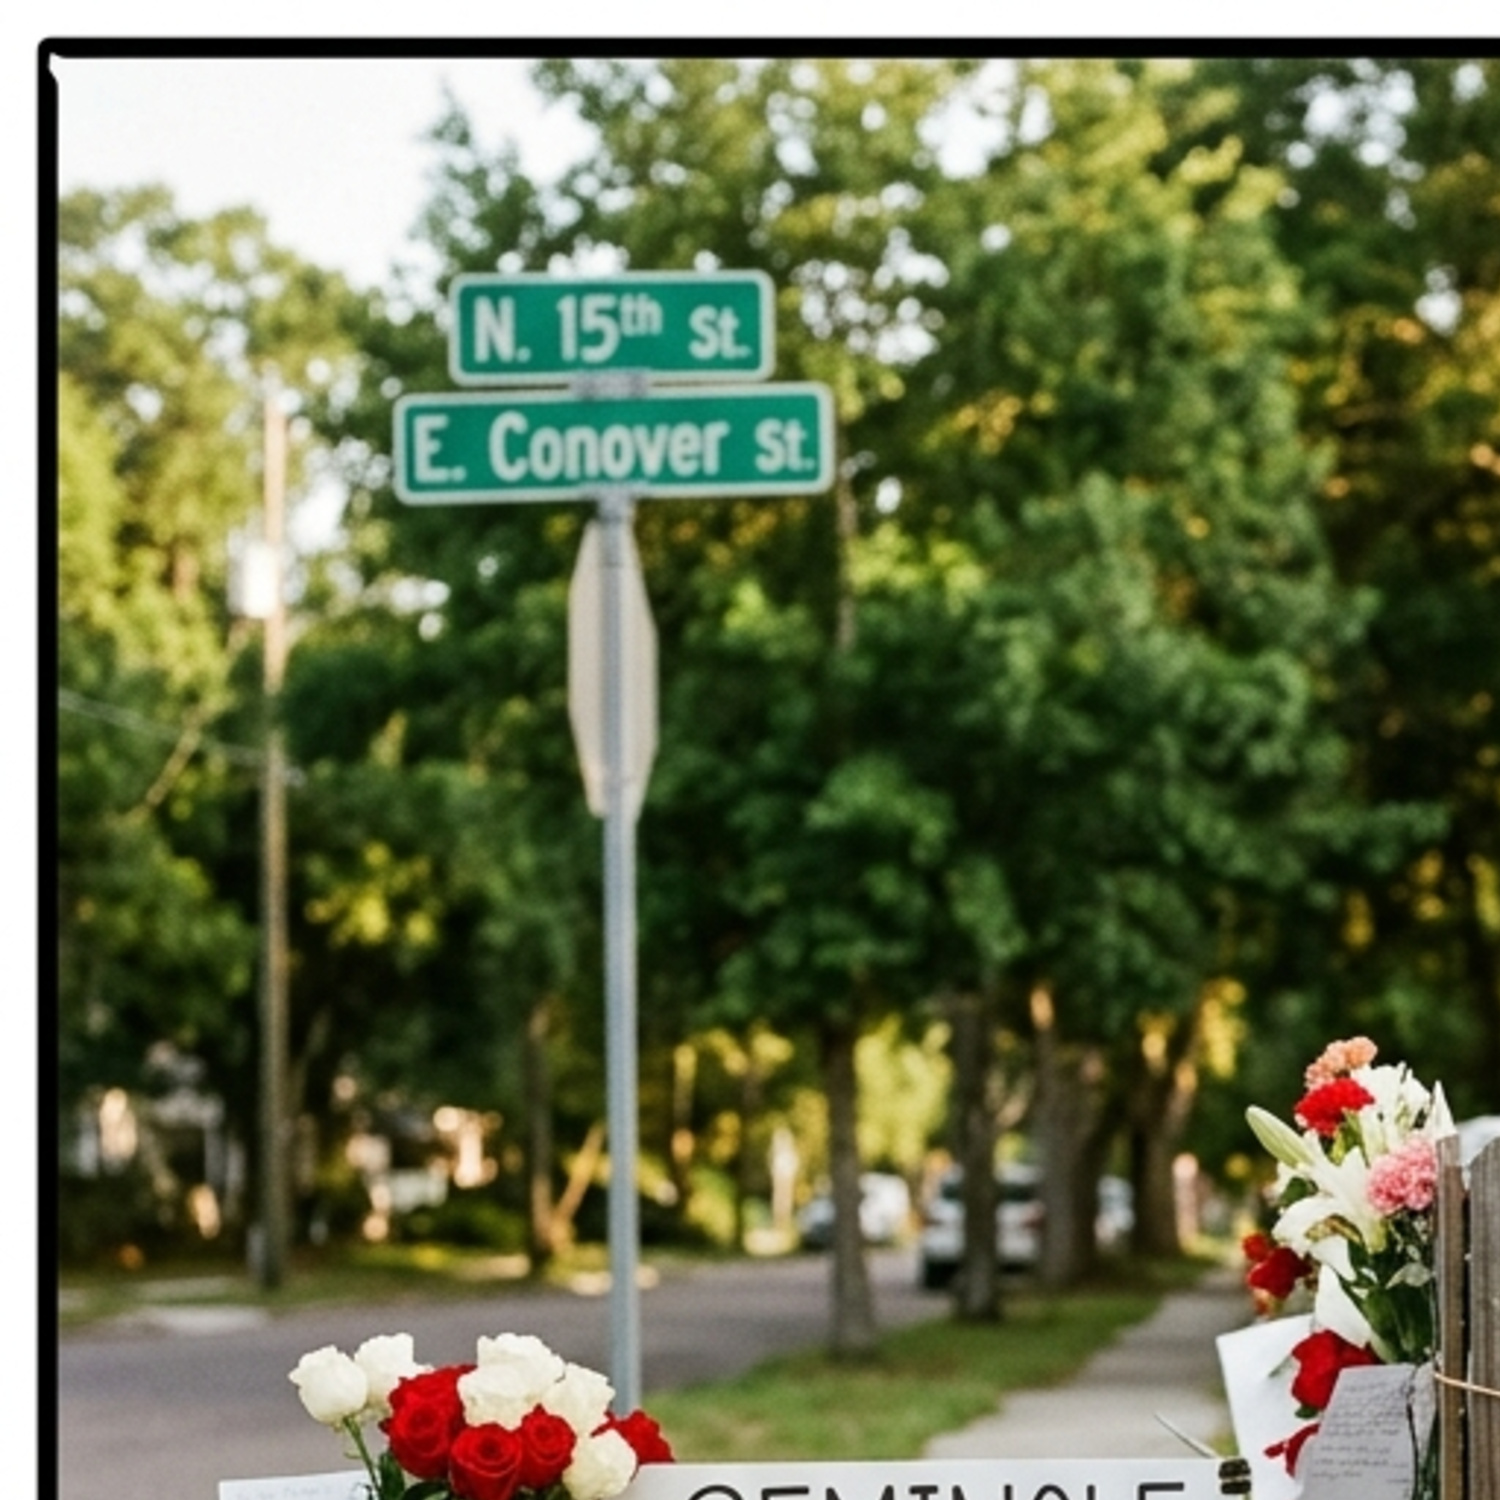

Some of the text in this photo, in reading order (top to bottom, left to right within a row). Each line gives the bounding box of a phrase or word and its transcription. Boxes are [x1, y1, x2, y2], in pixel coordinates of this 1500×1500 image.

[472, 293, 752, 364] N. 15th St.
[412, 410, 816, 483] E. Conover St.
